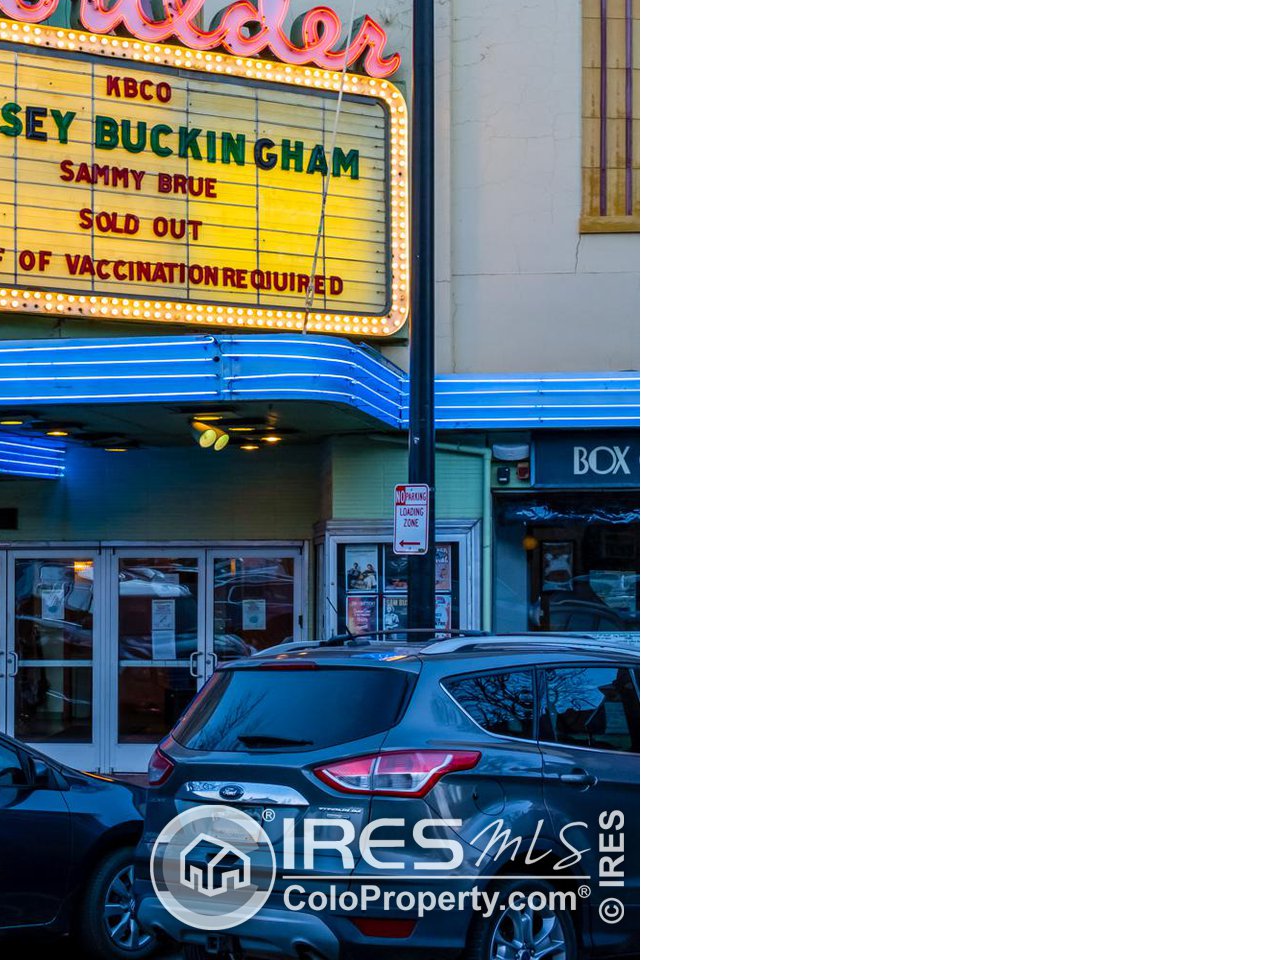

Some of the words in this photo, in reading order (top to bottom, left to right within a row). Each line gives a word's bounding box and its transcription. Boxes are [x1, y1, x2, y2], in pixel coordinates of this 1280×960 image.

[106, 75, 172, 103] KBCO
[94, 115, 360, 181] BUCKINGHAM
[59, 159, 145, 191] SAMMY
[158, 173, 217, 199] BRUE
[78, 208, 140, 235] SOLD
[152, 217, 203, 240] OUT
[18, 250, 53, 272] OF
[64, 253, 219, 287] VACCINATION
[573, 445, 632, 475] BOX
[395, 490, 406, 503] NO
[405, 492, 427, 501] PARKING
[399, 507, 424, 517] LOADING
[403, 518, 420, 528] ZONE
